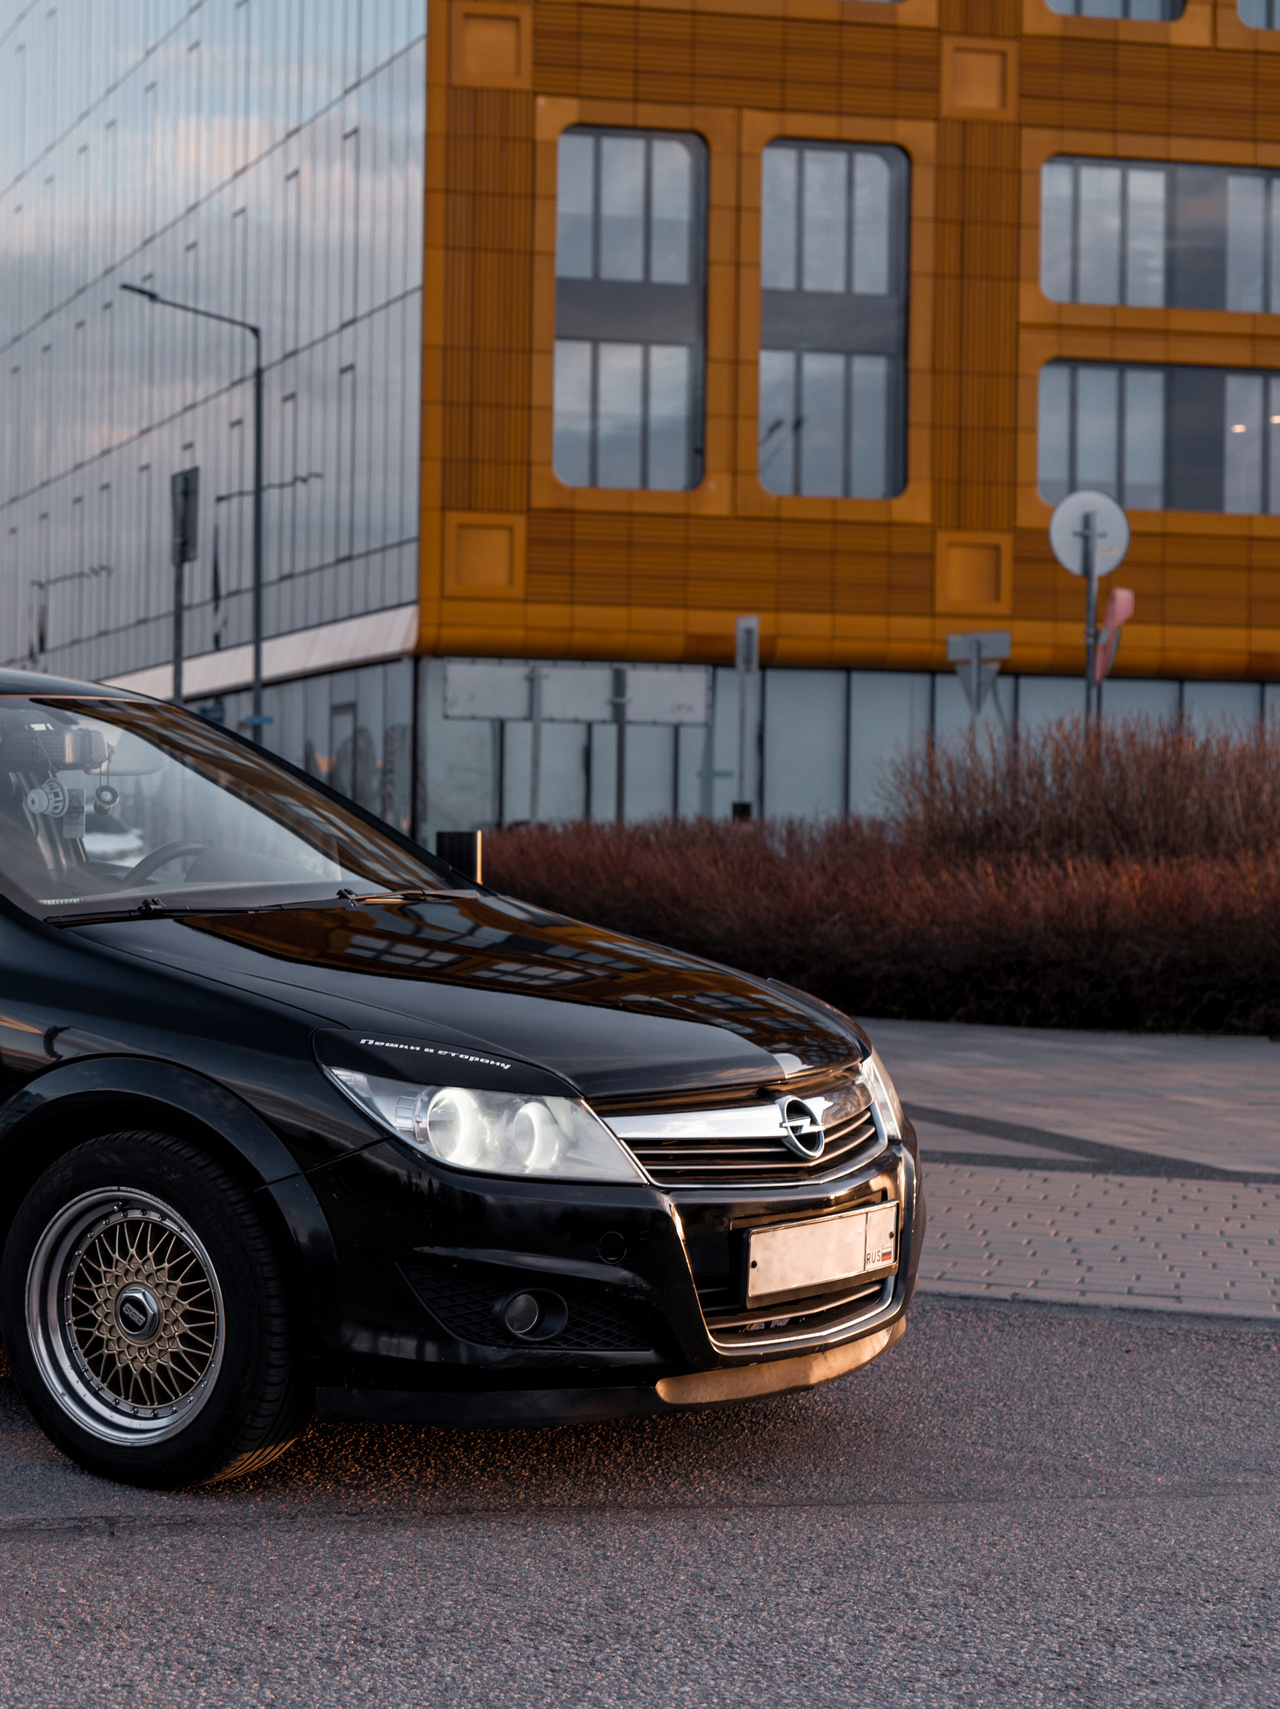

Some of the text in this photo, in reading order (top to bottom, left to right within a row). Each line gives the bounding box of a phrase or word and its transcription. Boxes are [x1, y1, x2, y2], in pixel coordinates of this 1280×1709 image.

[359, 1038, 421, 1051] Пешки
[437, 1049, 512, 1070] сторону
[866, 1250, 881, 1265] RUS
